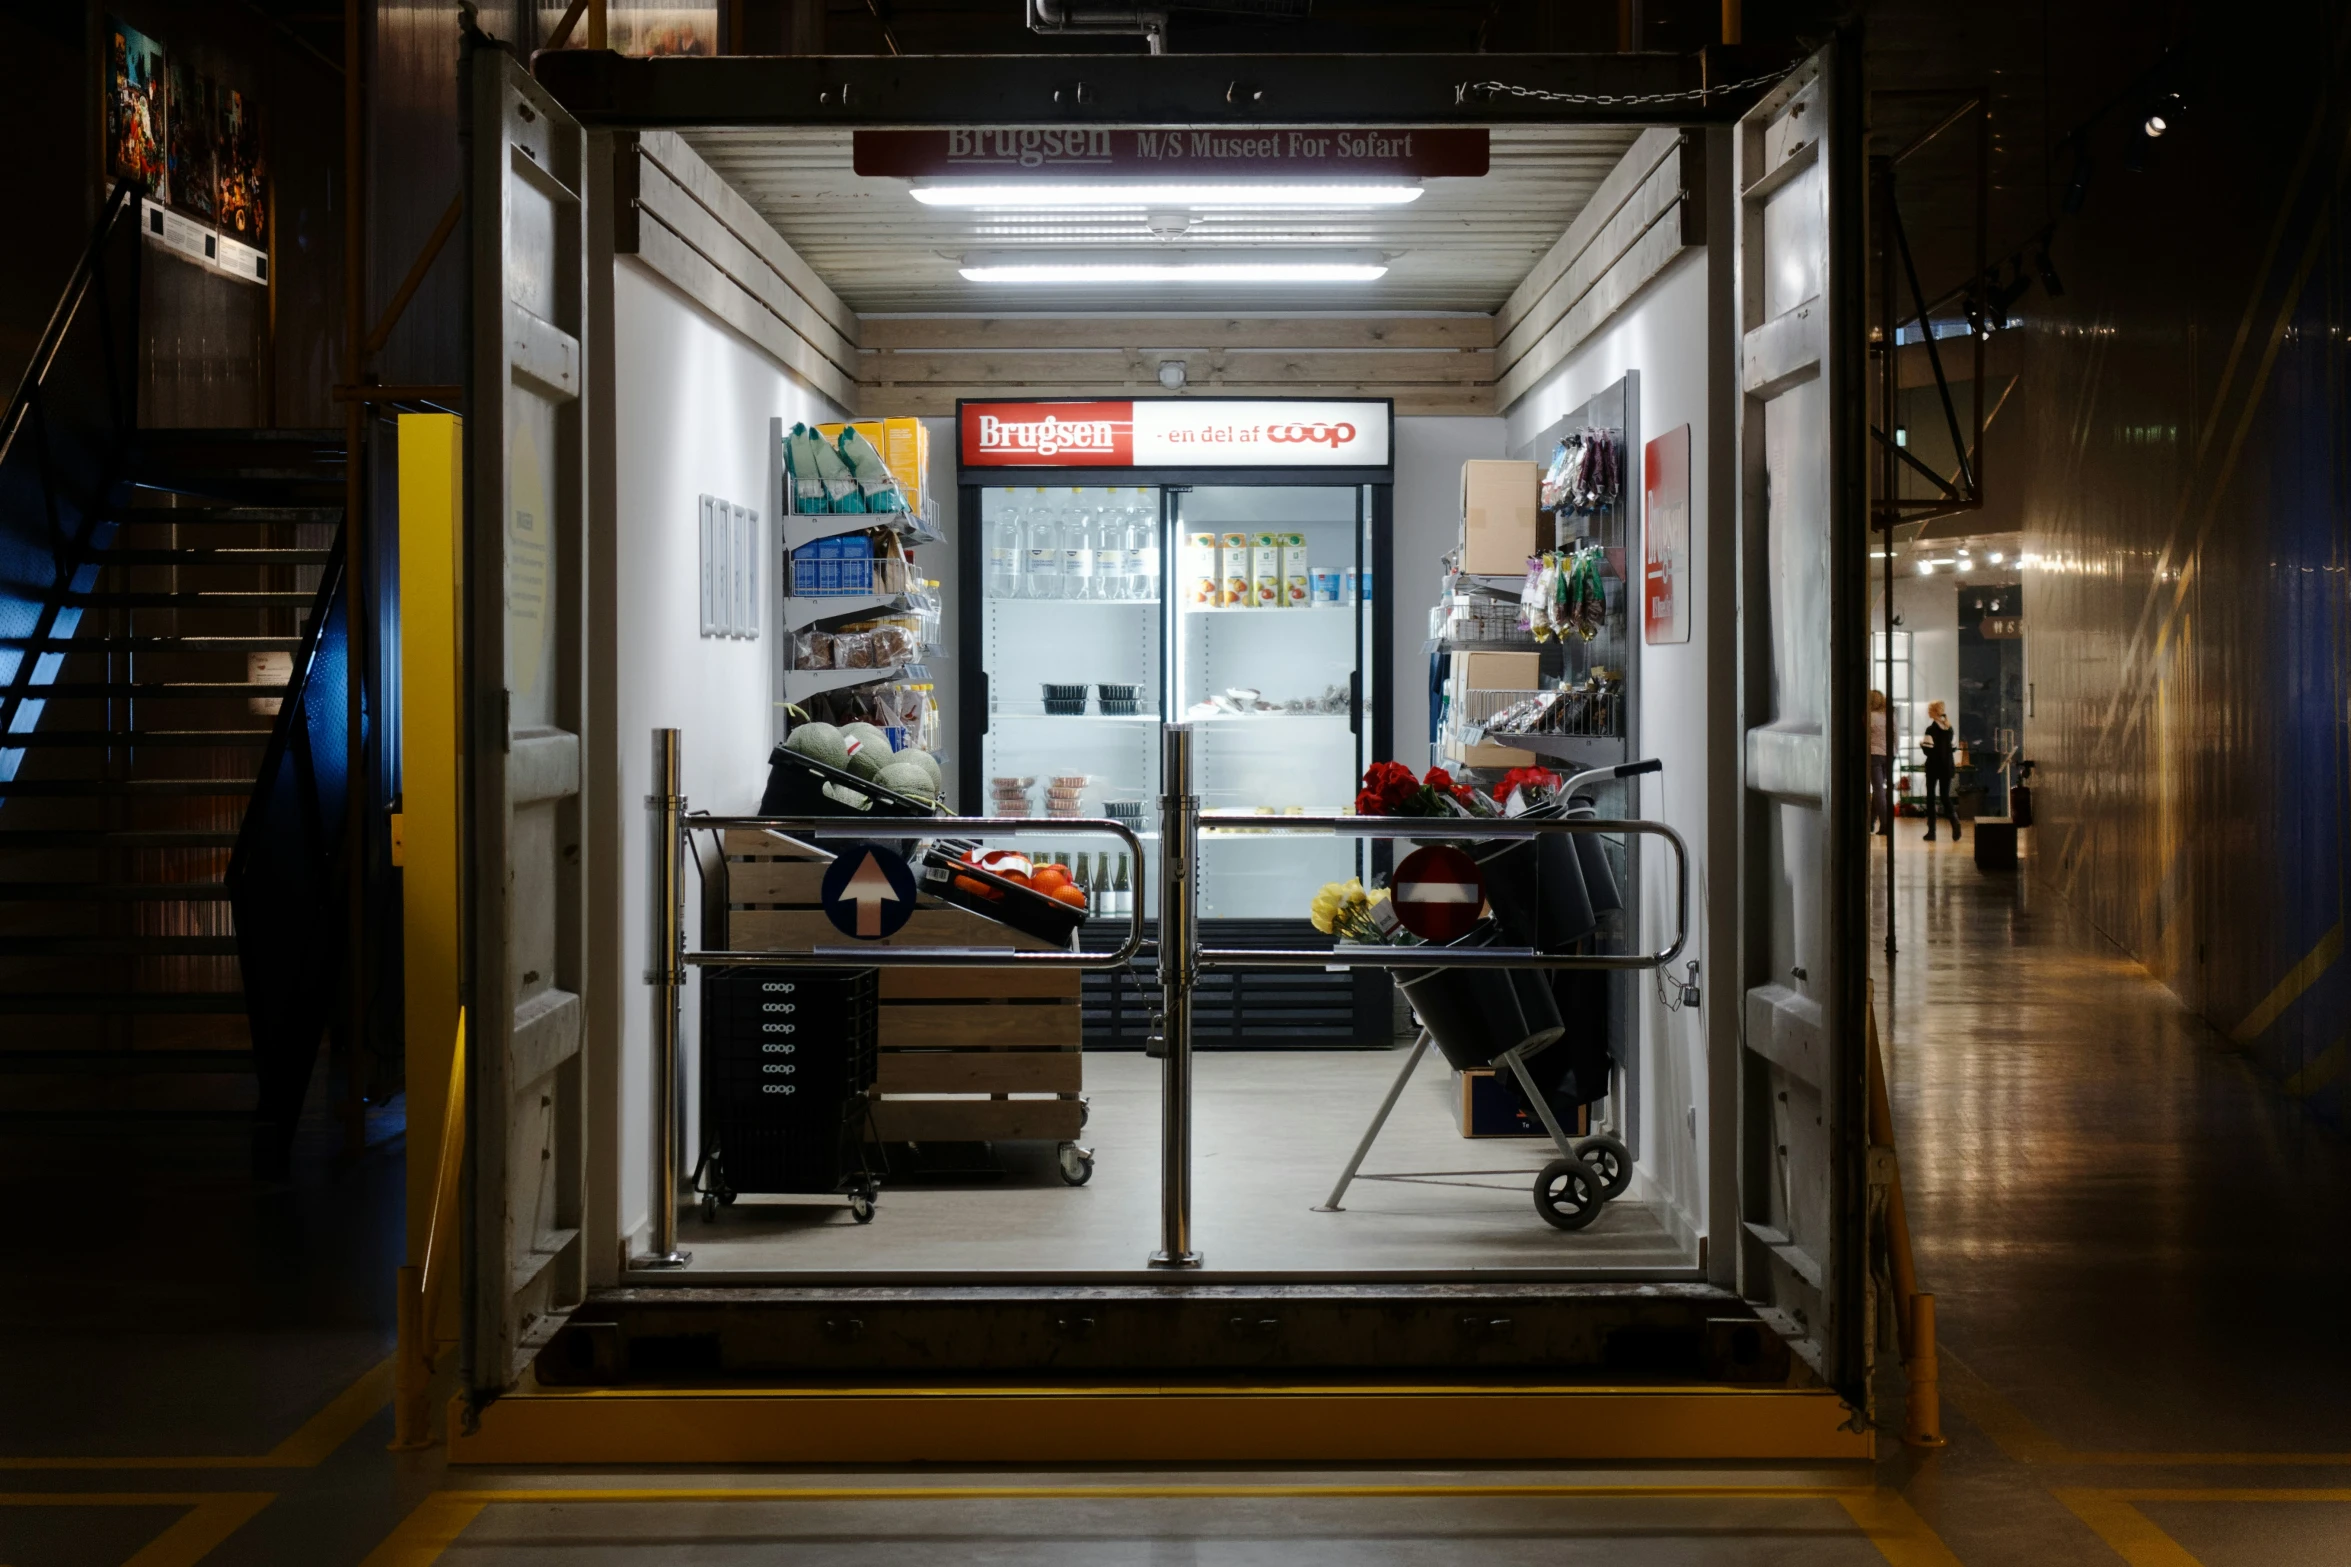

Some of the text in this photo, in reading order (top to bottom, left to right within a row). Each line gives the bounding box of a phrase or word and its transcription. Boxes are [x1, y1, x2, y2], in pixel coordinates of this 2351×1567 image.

[947, 130, 1112, 167] Brugsen
[1137, 132, 1413, 160] M/S Museet For Søfart
[979, 415, 1114, 455] Brugsen
[1169, 430, 1195, 442] en
[1202, 426, 1233, 442] del
[1240, 426, 1260, 442] af
[1267, 422, 1356, 448] coop
[762, 983, 794, 993] coop
[762, 1003, 794, 1013] coop
[762, 1024, 794, 1034] coop
[762, 1044, 794, 1054] coop
[762, 1065, 794, 1075] coop
[762, 1085, 794, 1095] coop
